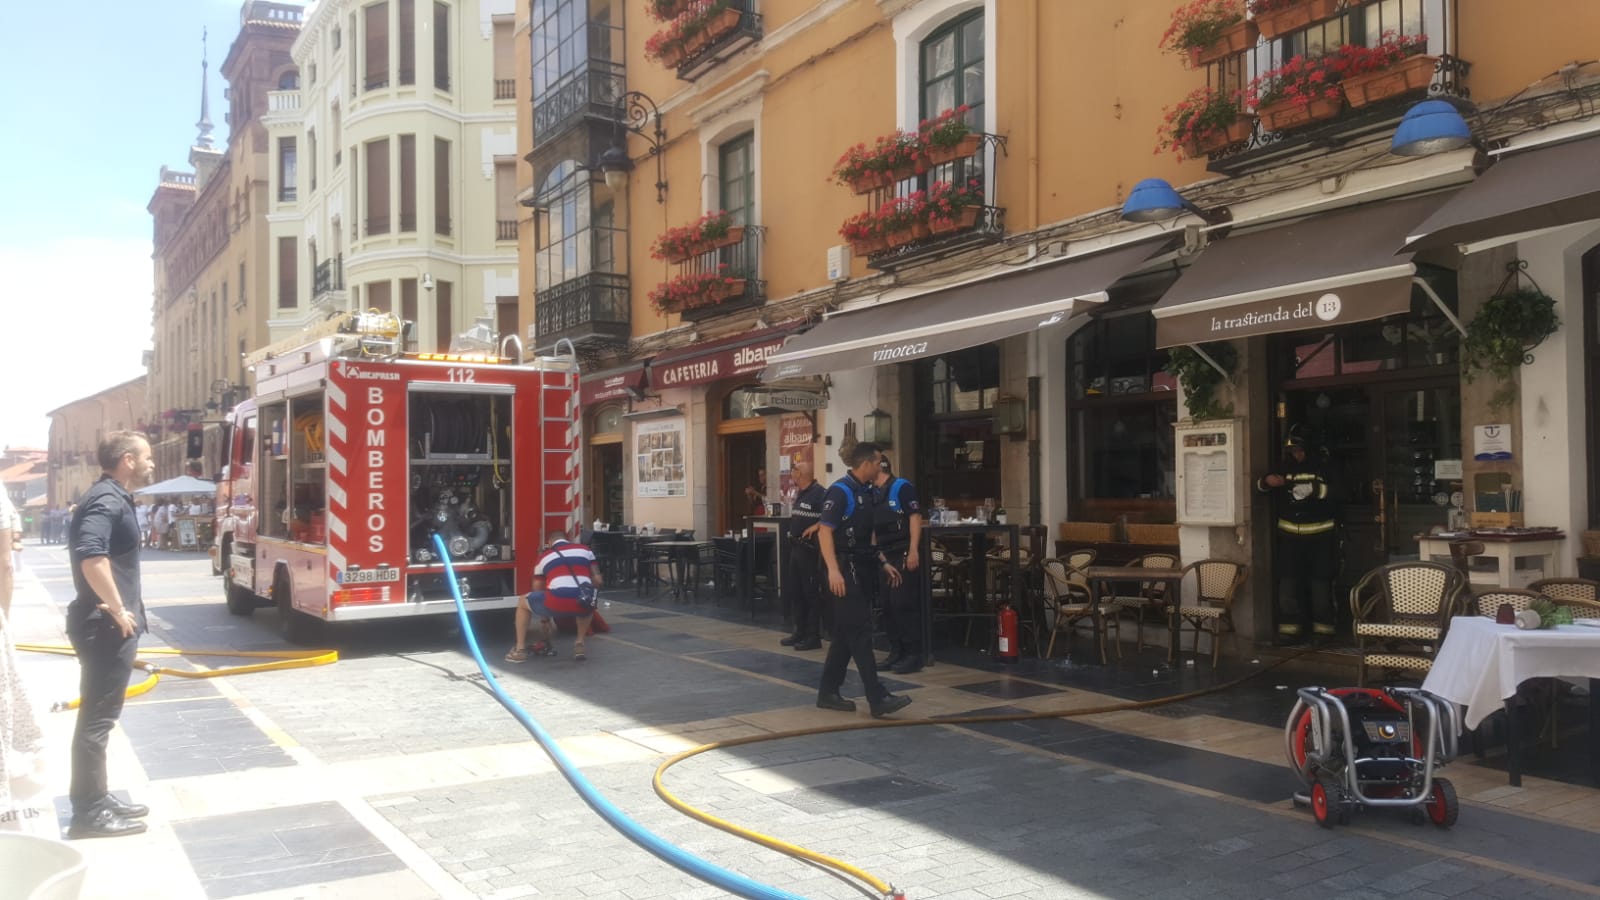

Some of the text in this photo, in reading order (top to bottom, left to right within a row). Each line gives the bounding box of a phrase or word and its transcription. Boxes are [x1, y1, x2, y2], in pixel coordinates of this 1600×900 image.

[1211, 301, 1336, 331] la trastienda del 13
[872, 341, 928, 361] vinoteca
[447, 367, 475, 383] 112
[663, 360, 719, 384] CAFETERIA
[783, 431, 814, 447] albany
[367, 386, 385, 553] BOMBEROS
[344, 569, 397, 582] 3298 HDB
